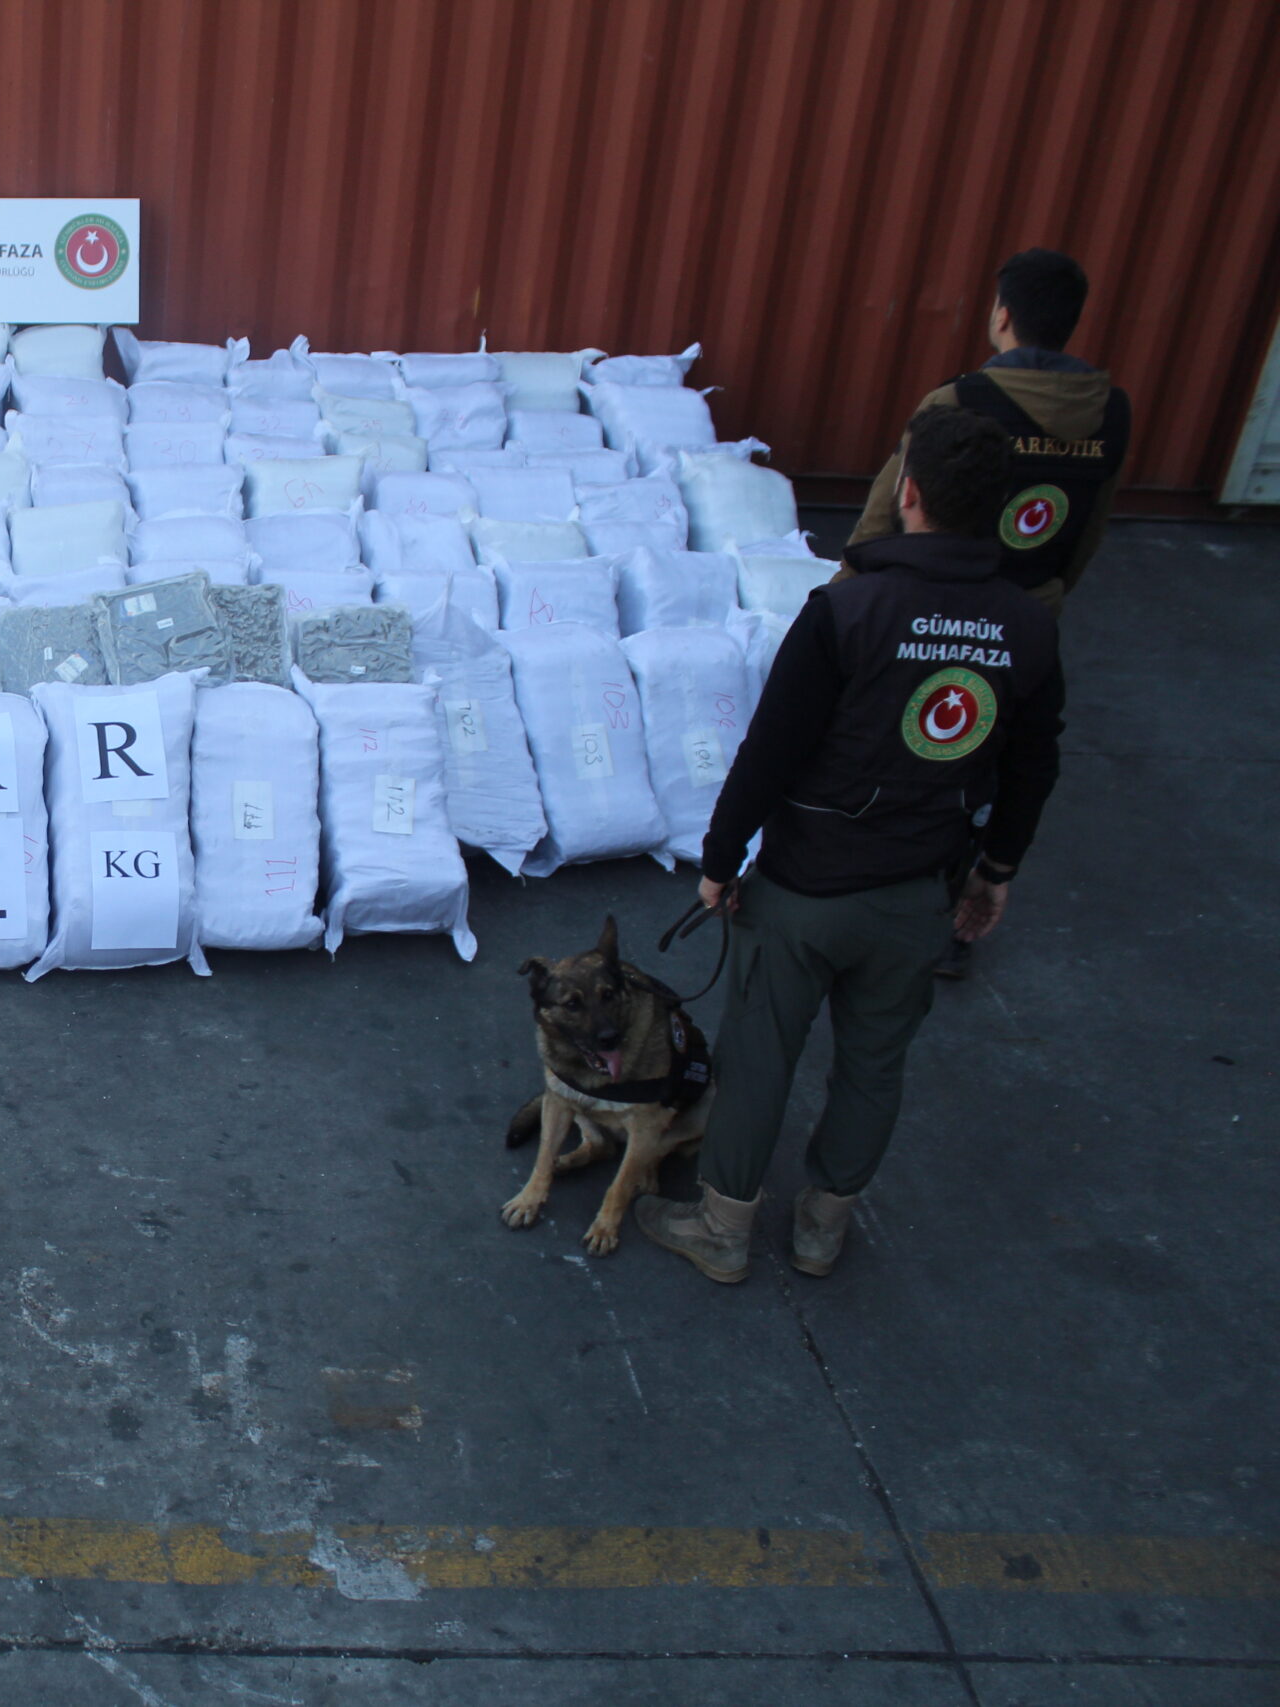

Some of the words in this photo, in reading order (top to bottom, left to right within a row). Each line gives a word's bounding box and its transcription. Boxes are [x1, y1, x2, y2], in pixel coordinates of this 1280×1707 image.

[911, 614, 1004, 642] GÜMRÜK
[896, 642, 1012, 668] MUHAFAZA
[103, 849, 162, 879] KG
